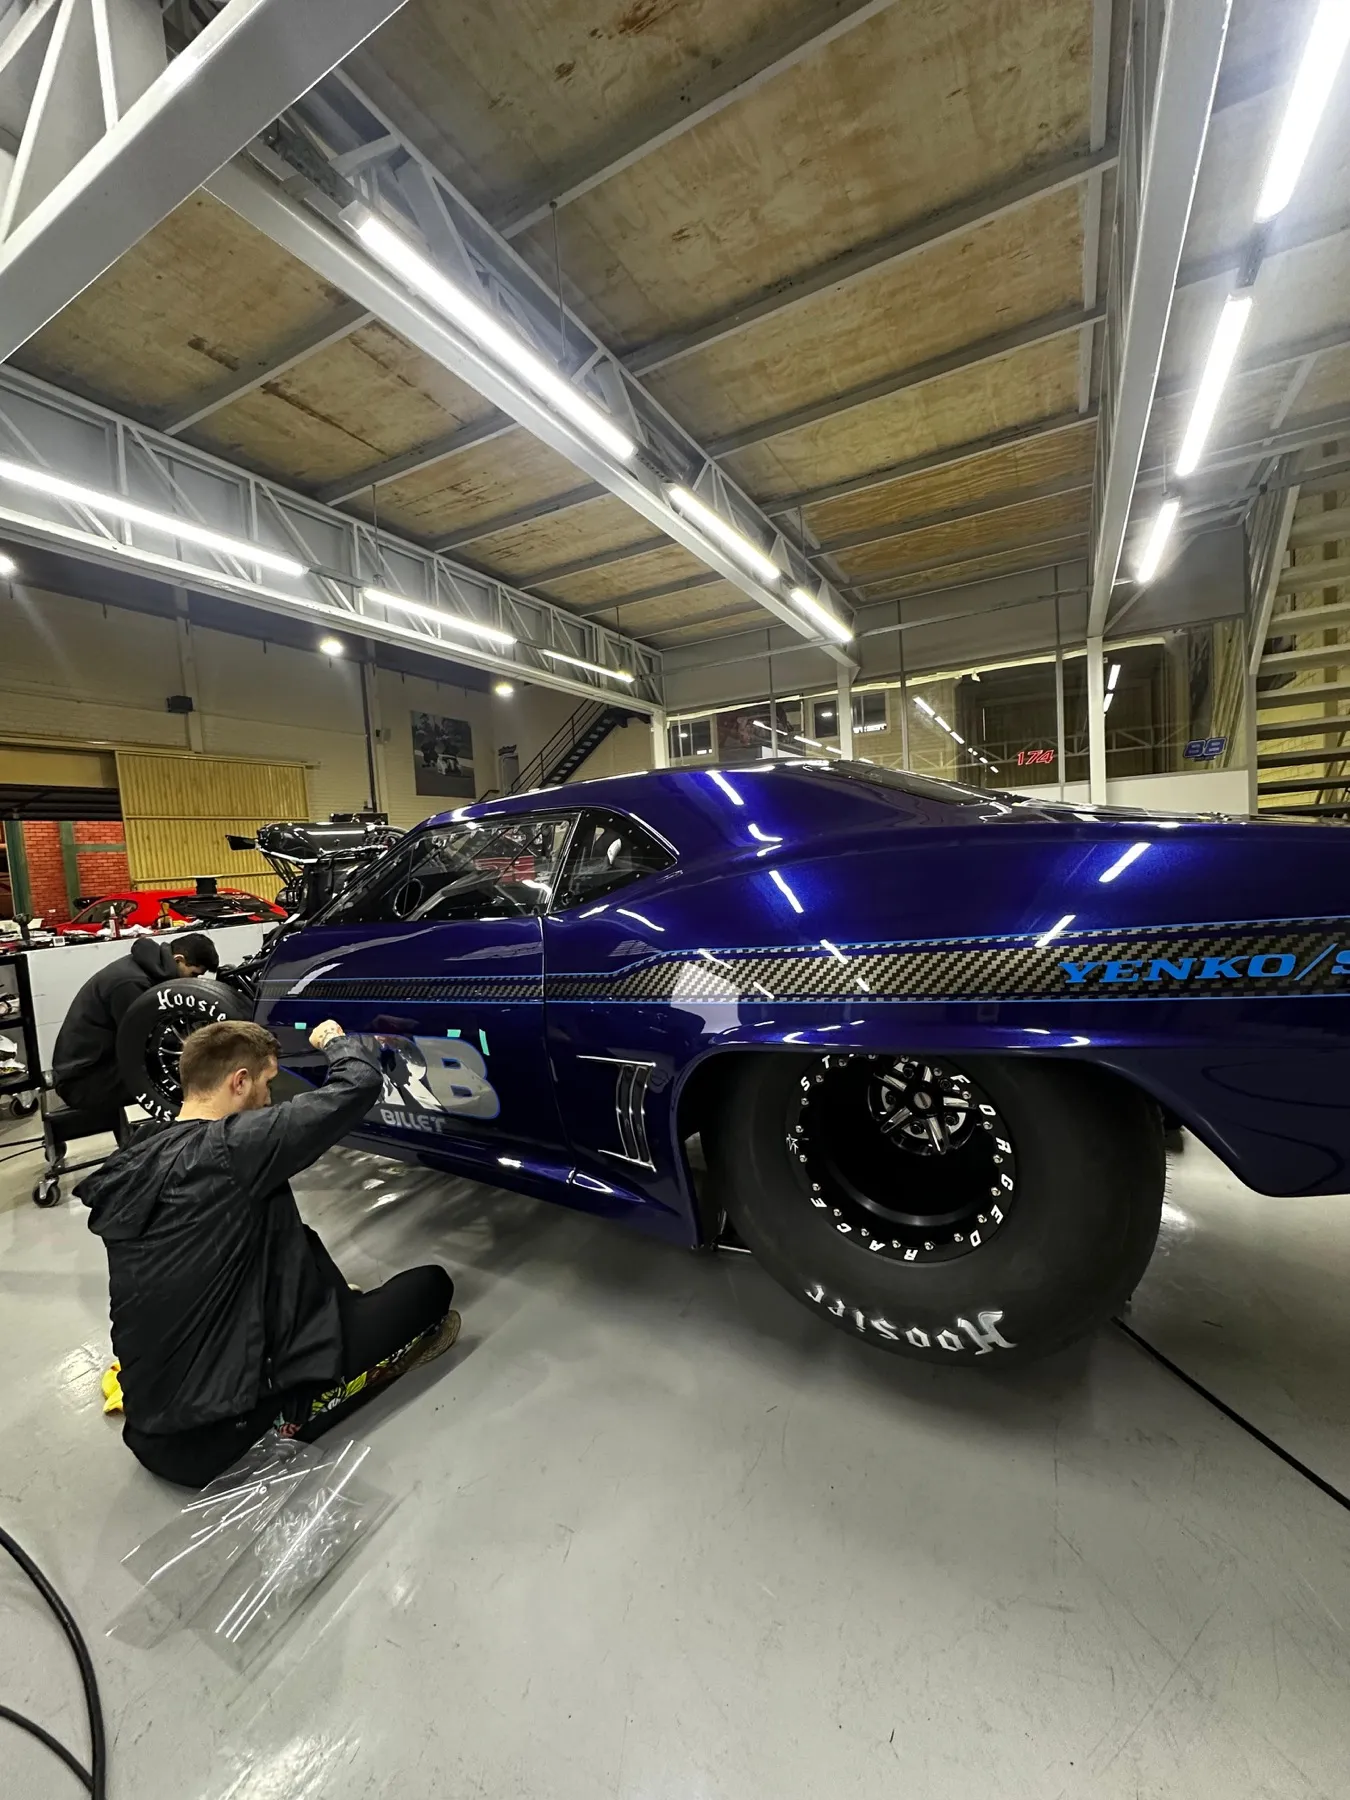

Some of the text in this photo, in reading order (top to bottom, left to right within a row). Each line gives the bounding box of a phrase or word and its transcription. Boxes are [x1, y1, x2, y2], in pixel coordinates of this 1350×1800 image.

[1017, 749, 1055, 766] 174
[157, 988, 227, 1022] Hoosie
[136, 1092, 173, 1123] sier
[380, 1108, 446, 1133] BILLET
[950, 1074, 1013, 1248] FORGED
[810, 1197, 919, 1261] RACE
[805, 1284, 1018, 1356] Hoosier
